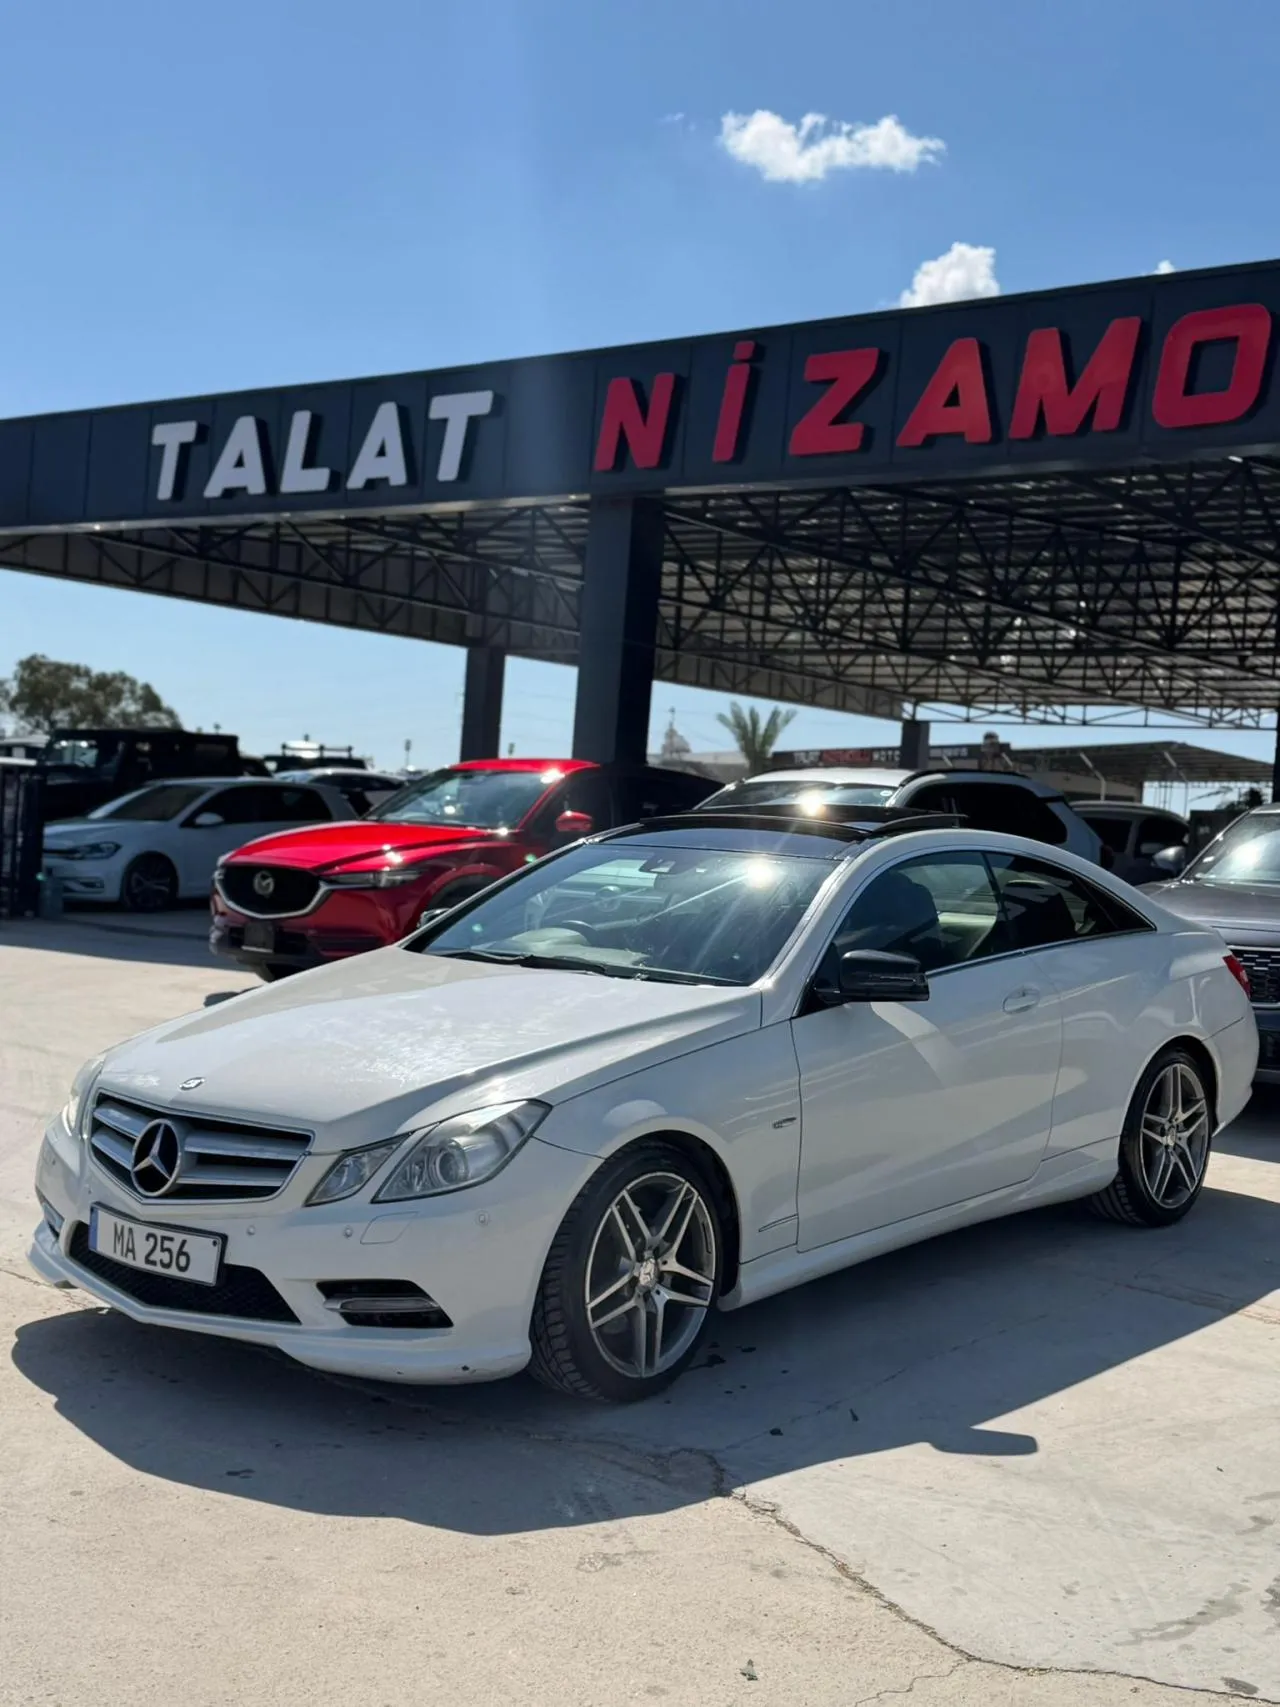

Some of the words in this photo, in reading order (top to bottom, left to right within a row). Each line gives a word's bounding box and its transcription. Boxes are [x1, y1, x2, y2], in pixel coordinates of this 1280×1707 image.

[152, 390, 494, 500] TALAT
[113, 1222, 136, 1261] MA
[144, 1232, 191, 1273] 256
